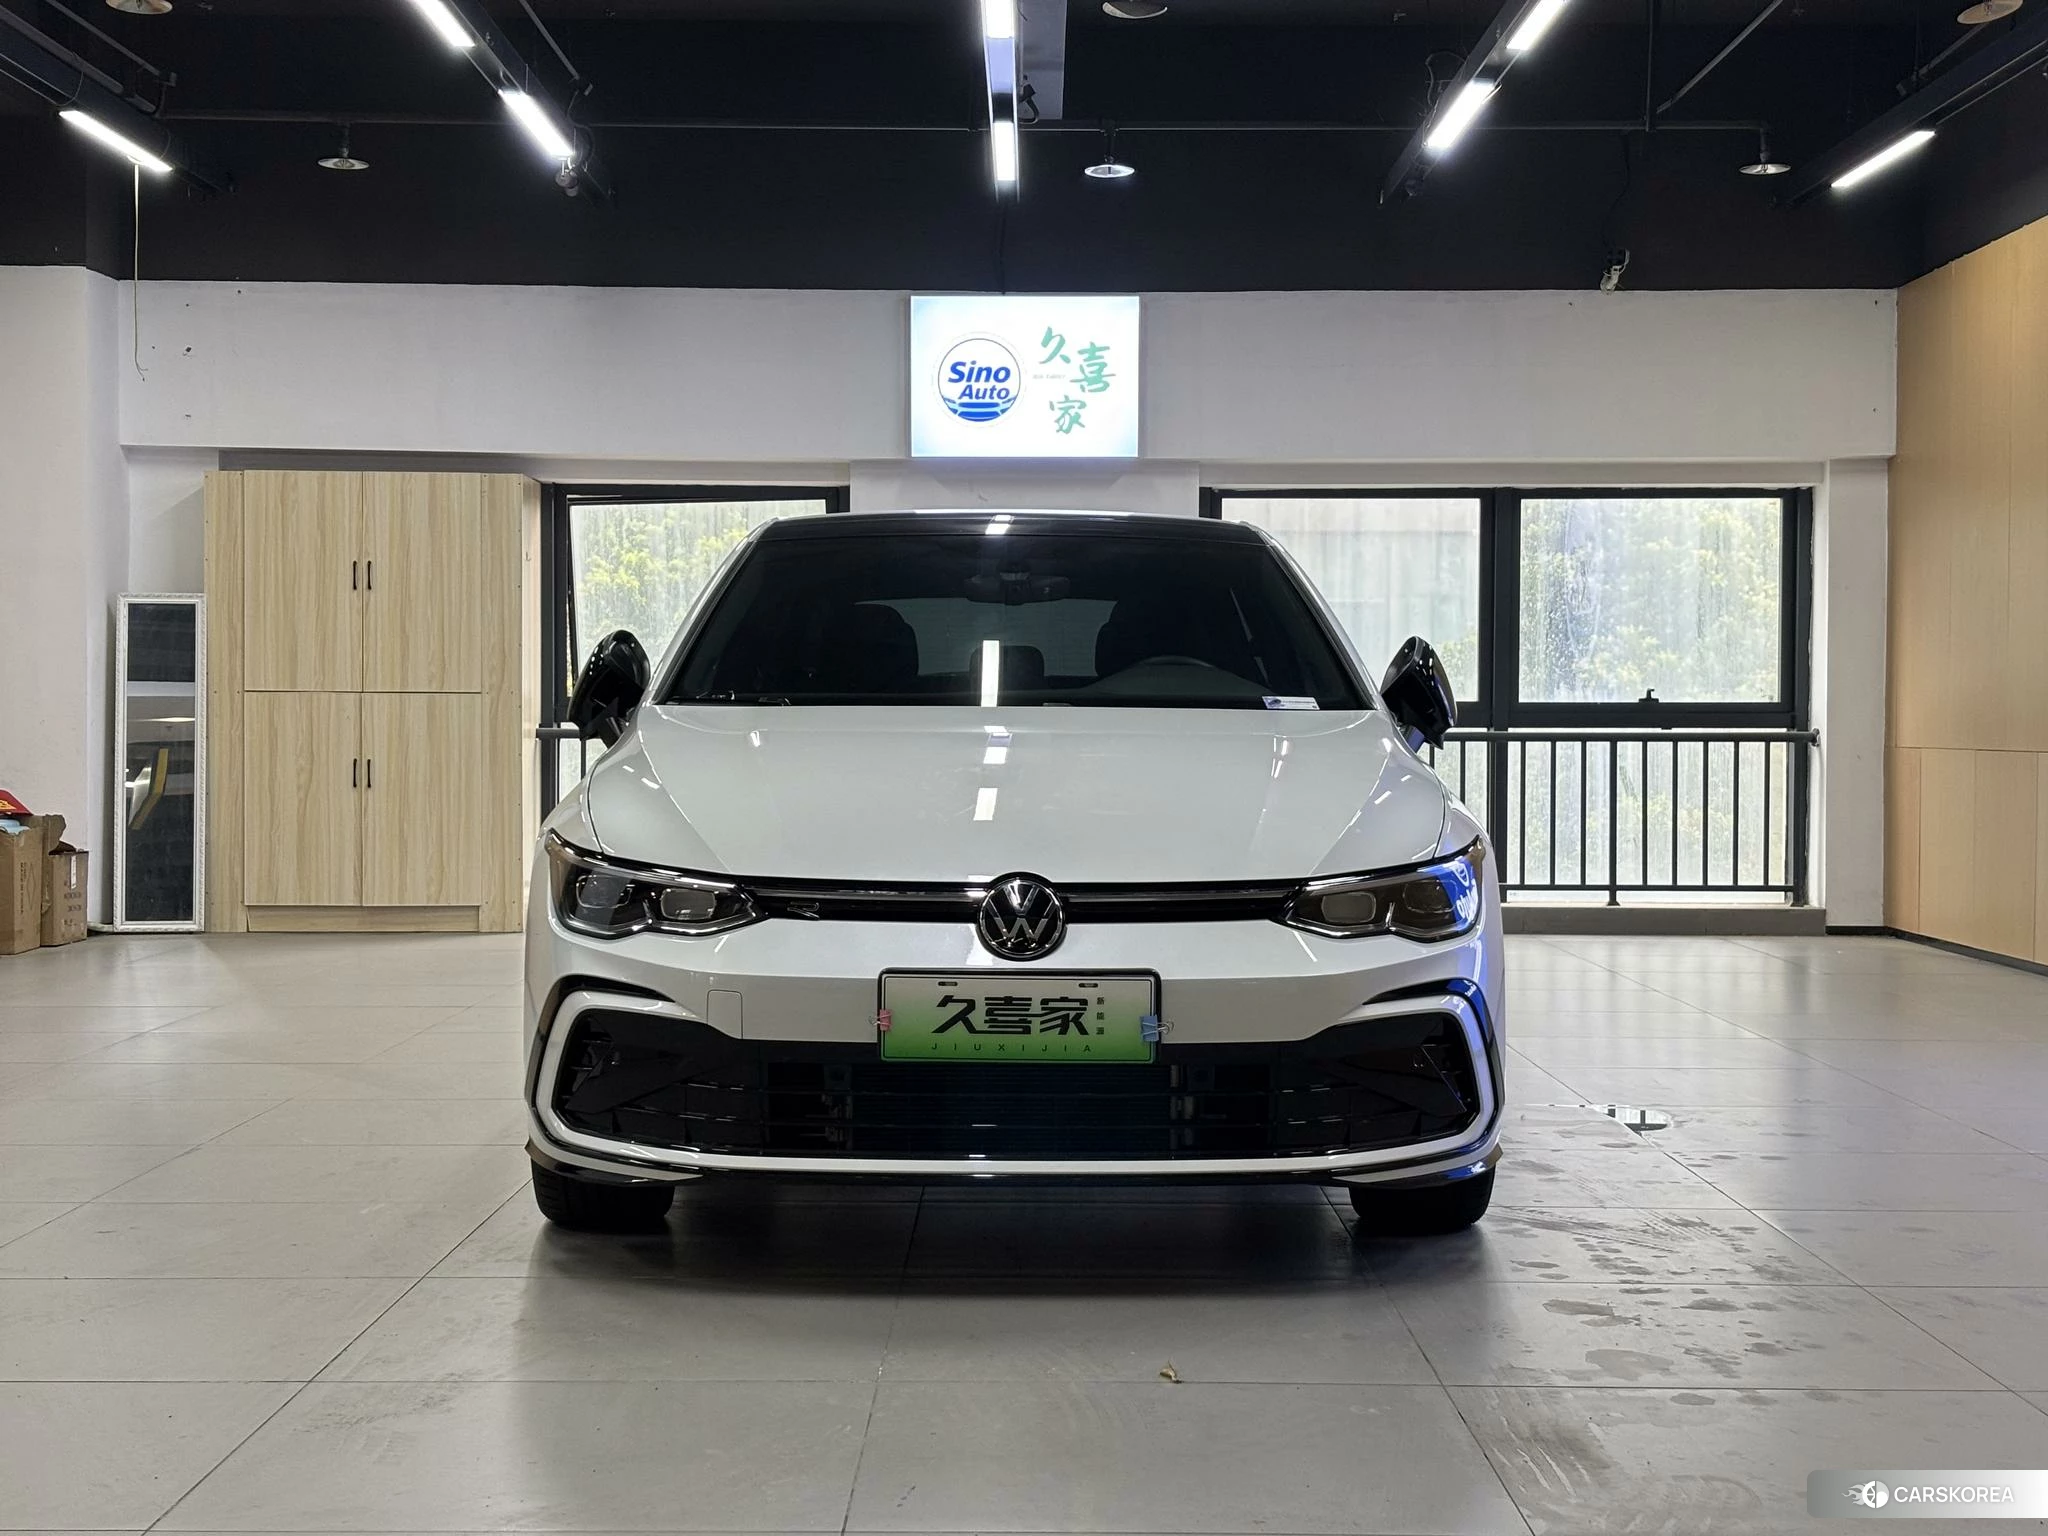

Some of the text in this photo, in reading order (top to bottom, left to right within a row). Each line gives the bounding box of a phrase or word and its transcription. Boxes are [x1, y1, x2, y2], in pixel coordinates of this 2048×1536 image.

[948, 360, 1011, 383] Sino
[1038, 326, 1116, 434] 久喜家
[958, 385, 1010, 400] Auto
[931, 995, 1089, 1035] 久喜家
